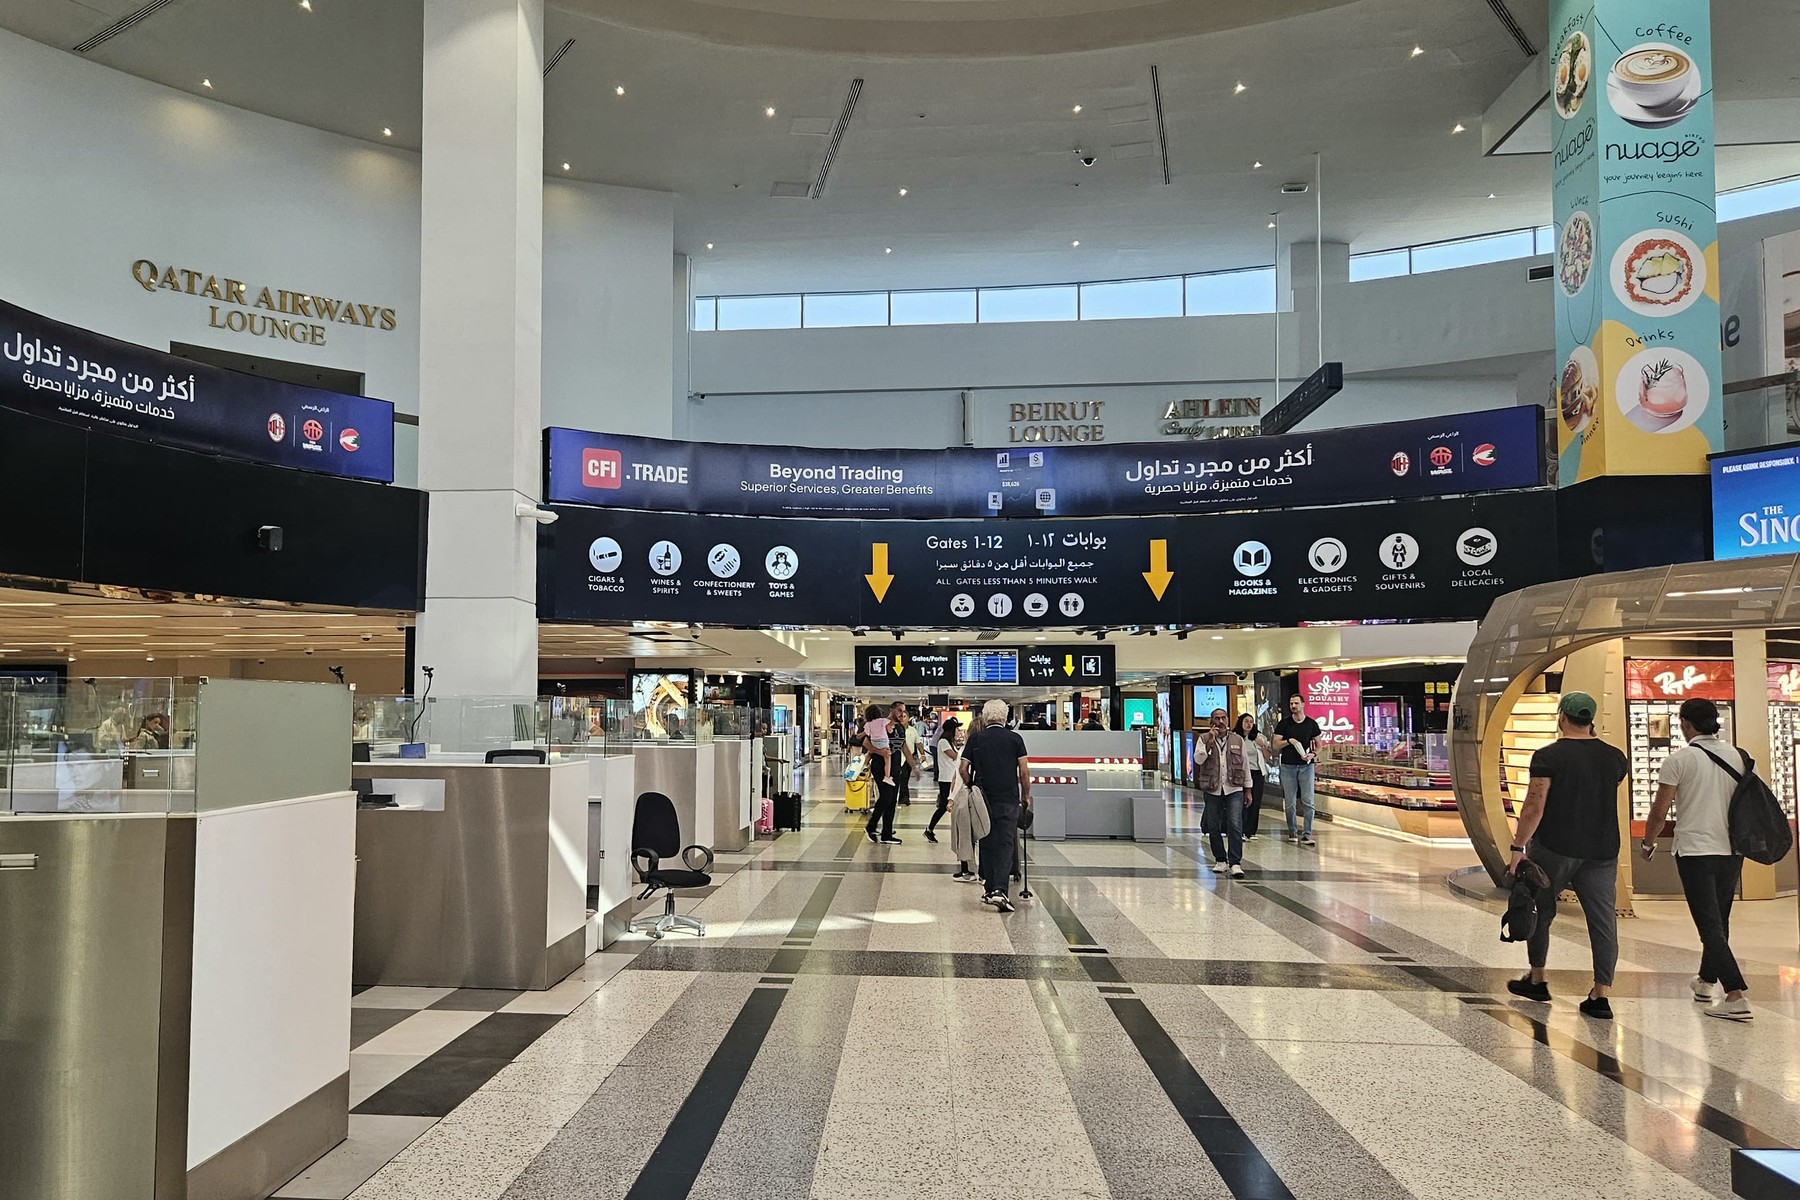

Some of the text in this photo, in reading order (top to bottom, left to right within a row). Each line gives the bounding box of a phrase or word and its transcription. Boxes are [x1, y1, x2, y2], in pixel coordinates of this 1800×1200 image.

[1554, 124, 1593, 170] nuage
[1606, 140, 1700, 163] nuage
[1603, 175, 1621, 184] your
[1622, 173, 1653, 184] journey
[1656, 171, 1683, 183] begins
[1656, 212, 1694, 231] Sushi
[131, 259, 397, 331] QATAR AIRWAYS
[208, 305, 327, 346] LOUNGE
[1626, 329, 1675, 348] Drinks
[3, 332, 196, 402] أكثر من مجرد تداول
[22, 369, 62, 392] حصرية
[63, 380, 90, 401] مزايا
[135, 401, 175, 420] خدمات
[1009, 401, 1105, 422] BEIRUT
[1163, 397, 1262, 419] AHLEIN
[1009, 424, 1105, 443] LOUNGE
[587, 459, 616, 478] CFI
[1125, 443, 1313, 482] أكثر من مجرد تداول
[770, 463, 903, 484] Beyond Trading
[1722, 465, 1743, 474] PLEASE
[1252, 475, 1293, 487] خدمات
[740, 480, 934, 495] Superior Services, Greater Benefits
[1144, 483, 1181, 496] حصرية
[1183, 481, 1207, 494] مزايا
[1762, 505, 1784, 516] THE
[926, 535, 1003, 549] Gates 1-12
[1062, 532, 1107, 550] بوابات
[960, 560, 986, 572] دقائق
[994, 561, 1009, 571] من
[1010, 555, 1027, 571] أقل
[1029, 558, 1066, 570] البوابات
[1067, 560, 1094, 572] جميع
[588, 575, 616, 583] CIGARS
[1382, 573, 1408, 581] GIFTS
[1462, 569, 1493, 577] LOCAL
[650, 578, 675, 586] WINES
[693, 580, 756, 589] CONFECTIONERY
[768, 582, 788, 590] TOYS
[1002, 577, 1026, 585] THAN
[1029, 577, 1034, 585] 5
[1036, 577, 1072, 585] MINUTES
[1073, 576, 1098, 584] WALK
[1233, 578, 1272, 587] BOOKS &
[1298, 575, 1358, 585] ELECTRONICS
[1375, 581, 1426, 591] SOUVENIRS
[1451, 577, 1505, 587] DELICACIES
[588, 584, 625, 593] TOBACCO
[652, 587, 680, 595] SPIRITS
[713, 589, 743, 597] SWEETS
[769, 590, 795, 598] GAMES
[1228, 587, 1278, 596] MAGAZINES
[1302, 584, 1353, 593] & GADGETS
[1029, 654, 1051, 665] بوابات
[920, 666, 944, 677] 1-12
[1333, 734, 1354, 743] من
[1030, 776, 1078, 784] PRADA
